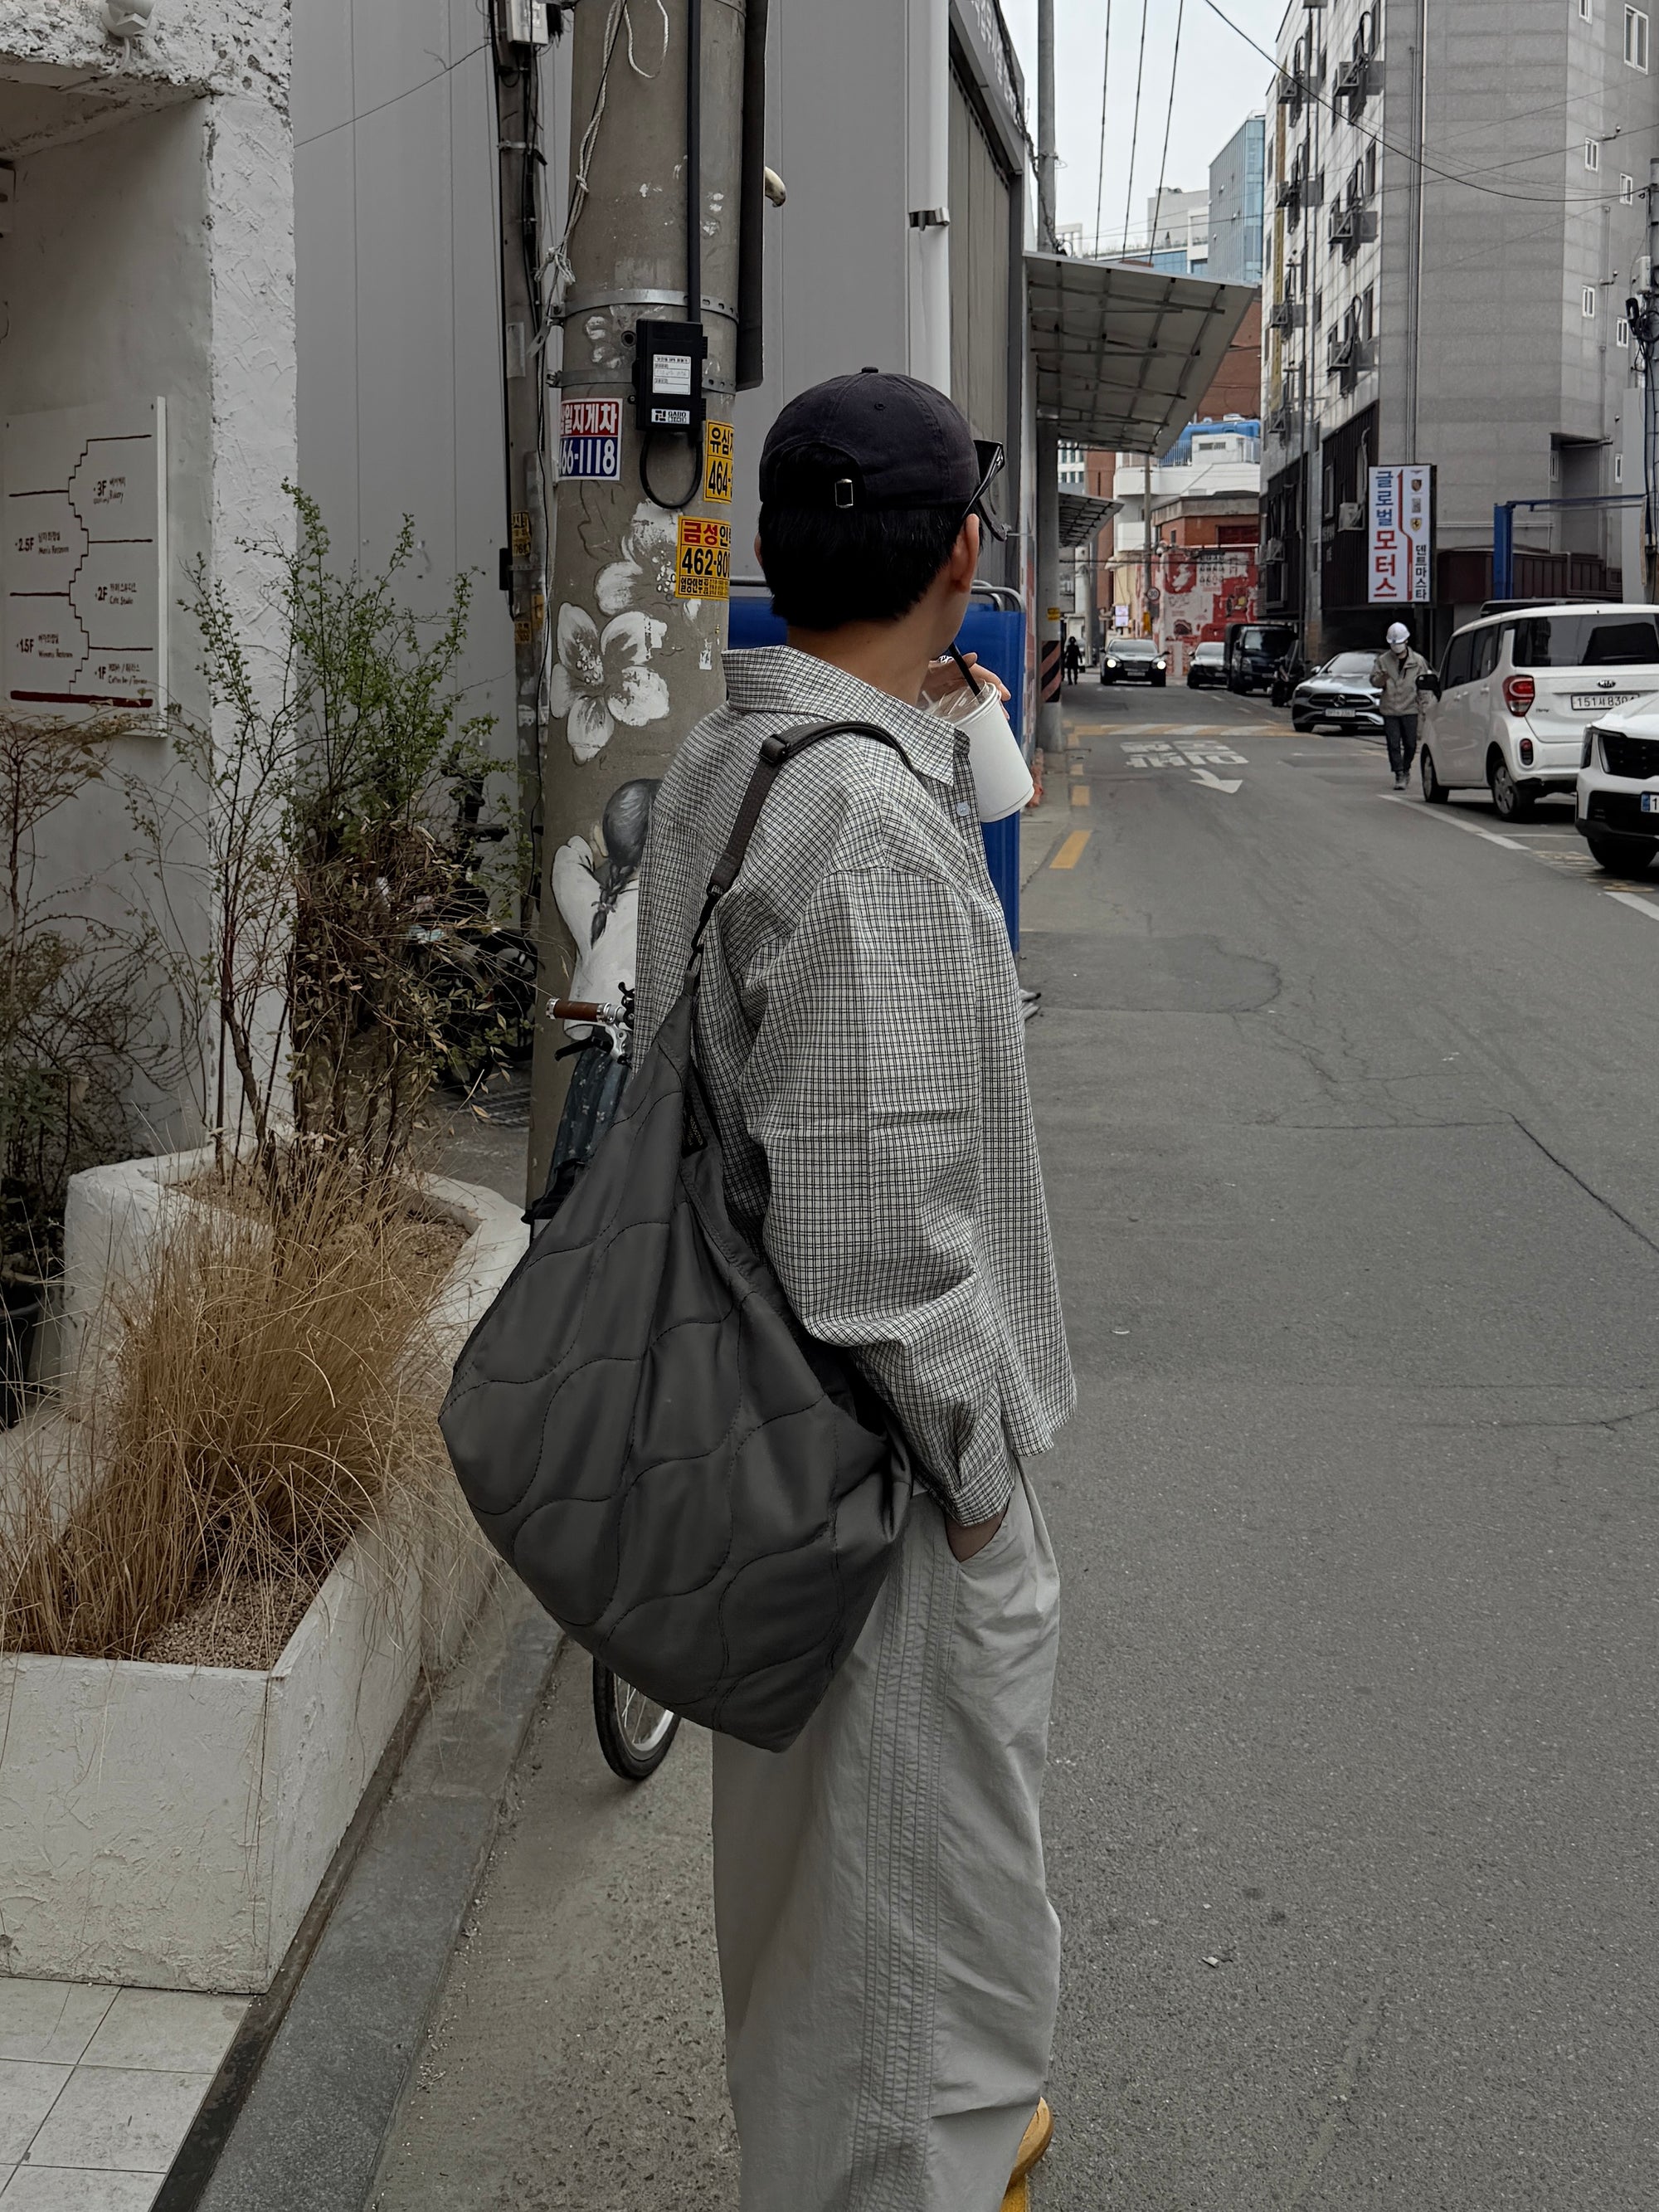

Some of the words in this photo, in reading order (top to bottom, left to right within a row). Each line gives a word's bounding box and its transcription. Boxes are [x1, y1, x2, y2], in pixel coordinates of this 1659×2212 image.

[559, 439, 615, 475] 66-1118
[97, 480, 107, 497] 3F
[708, 460, 732, 497] 464-
[1375, 470, 1394, 527] 글로벌
[18, 538, 34, 552] 2.5F
[684, 521, 731, 548] 금성인
[1374, 529, 1398, 598] 모터스
[1415, 544, 1427, 600] 덴트마스타
[98, 586, 108, 601] 2F
[98, 665, 106, 680] 1F
